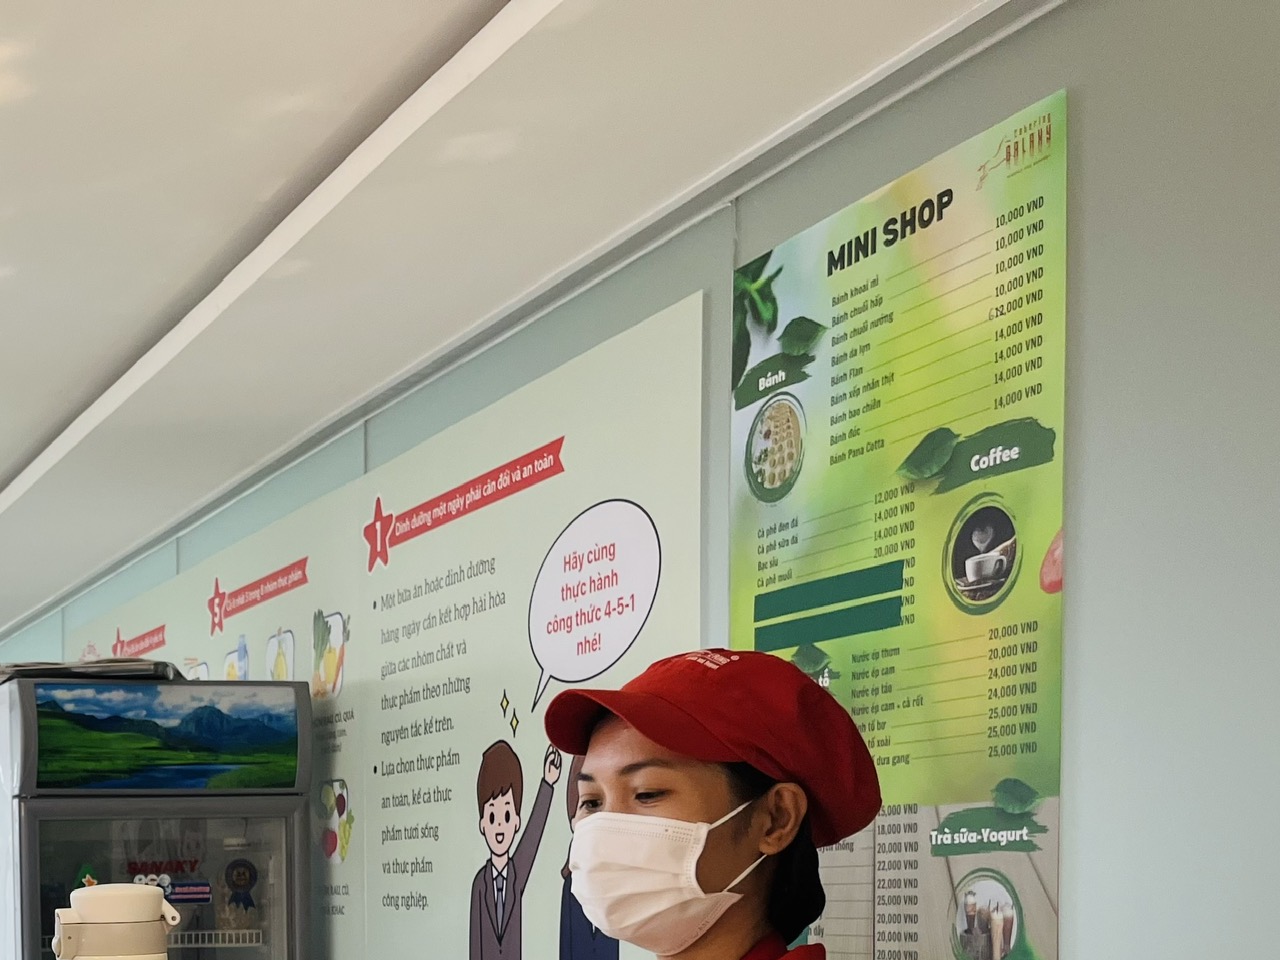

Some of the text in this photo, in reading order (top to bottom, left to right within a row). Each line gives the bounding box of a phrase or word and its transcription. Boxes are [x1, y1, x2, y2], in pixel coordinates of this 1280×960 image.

[995, 196, 1044, 228] 10,000 VND
[827, 188, 953, 277] MINI SHOP
[995, 219, 1044, 251] 10,000 VND
[995, 244, 1044, 274] 10,000 VND
[995, 267, 1044, 297] 10,000 VND
[995, 312, 1043, 341] 14,000 VND
[994, 335, 1043, 363] 14,000 VND
[759, 370, 786, 391] Bánh
[831, 367, 863, 387] Bánh Flan
[994, 356, 1043, 384] 14,000 VND
[994, 383, 1042, 410] 14,000 VND
[830, 412, 846, 426] Bánh
[849, 408, 860, 419] bao
[830, 439, 884, 465] Bánh Pana Cotta
[970, 445, 1020, 472] Coffee
[395, 522, 411, 536] Dinh
[447, 494, 465, 515] ngày
[522, 465, 533, 479] an
[534, 453, 554, 474] toàn
[900, 483, 915, 496] VND
[874, 501, 915, 523] 14,000 VND
[375, 521, 381, 552] 1
[874, 520, 915, 541] 14,000 VND
[564, 542, 616, 573] Hãy cùng
[873, 538, 915, 559] 20,000 VND
[381, 594, 396, 612] Một
[424, 576, 444, 595] hoặc
[445, 565, 466, 588] dinh
[467, 557, 496, 580] dưỡng
[561, 569, 619, 603] thực hành
[214, 597, 220, 624] 5
[402, 620, 421, 639] ngày
[453, 602, 471, 622] hợp
[488, 591, 506, 610] hòa
[546, 593, 635, 635] công thức 4-5-1
[988, 620, 1038, 640] 20,000 VND
[577, 632, 602, 656] nhé!
[988, 641, 1038, 660] 20,000 VND
[398, 657, 410, 672] các
[411, 650, 435, 669] nhóm
[456, 638, 467, 656] và
[988, 661, 1037, 680] 24,000 VND
[381, 693, 398, 711] thực
[423, 682, 441, 700] theo
[442, 676, 471, 698] những
[988, 681, 1037, 700] 24,000 VND
[988, 702, 1038, 720] 25,000 VND
[987, 721, 1037, 739] 25,000 VND
[988, 741, 1038, 758] 25,000 VND
[381, 761, 395, 778] Lựa
[396, 757, 415, 774] chọn
[417, 754, 435, 771] thực
[404, 823, 419, 840] tươi
[420, 821, 439, 842] sống
[877, 822, 918, 835] 18,000 VND
[930, 826, 1029, 846] Trà sữa-Yogurt
[877, 841, 918, 854] 20,000 VND
[382, 861, 391, 874] và
[392, 858, 409, 875] thực
[877, 859, 918, 872] 22,000 VND
[877, 878, 918, 890] 22,000 VND
[877, 895, 918, 906] 25,000 VND
[877, 913, 918, 925] 20,000 VND
[877, 931, 918, 943] 20,000 VND
[877, 950, 902, 960] 20,000
